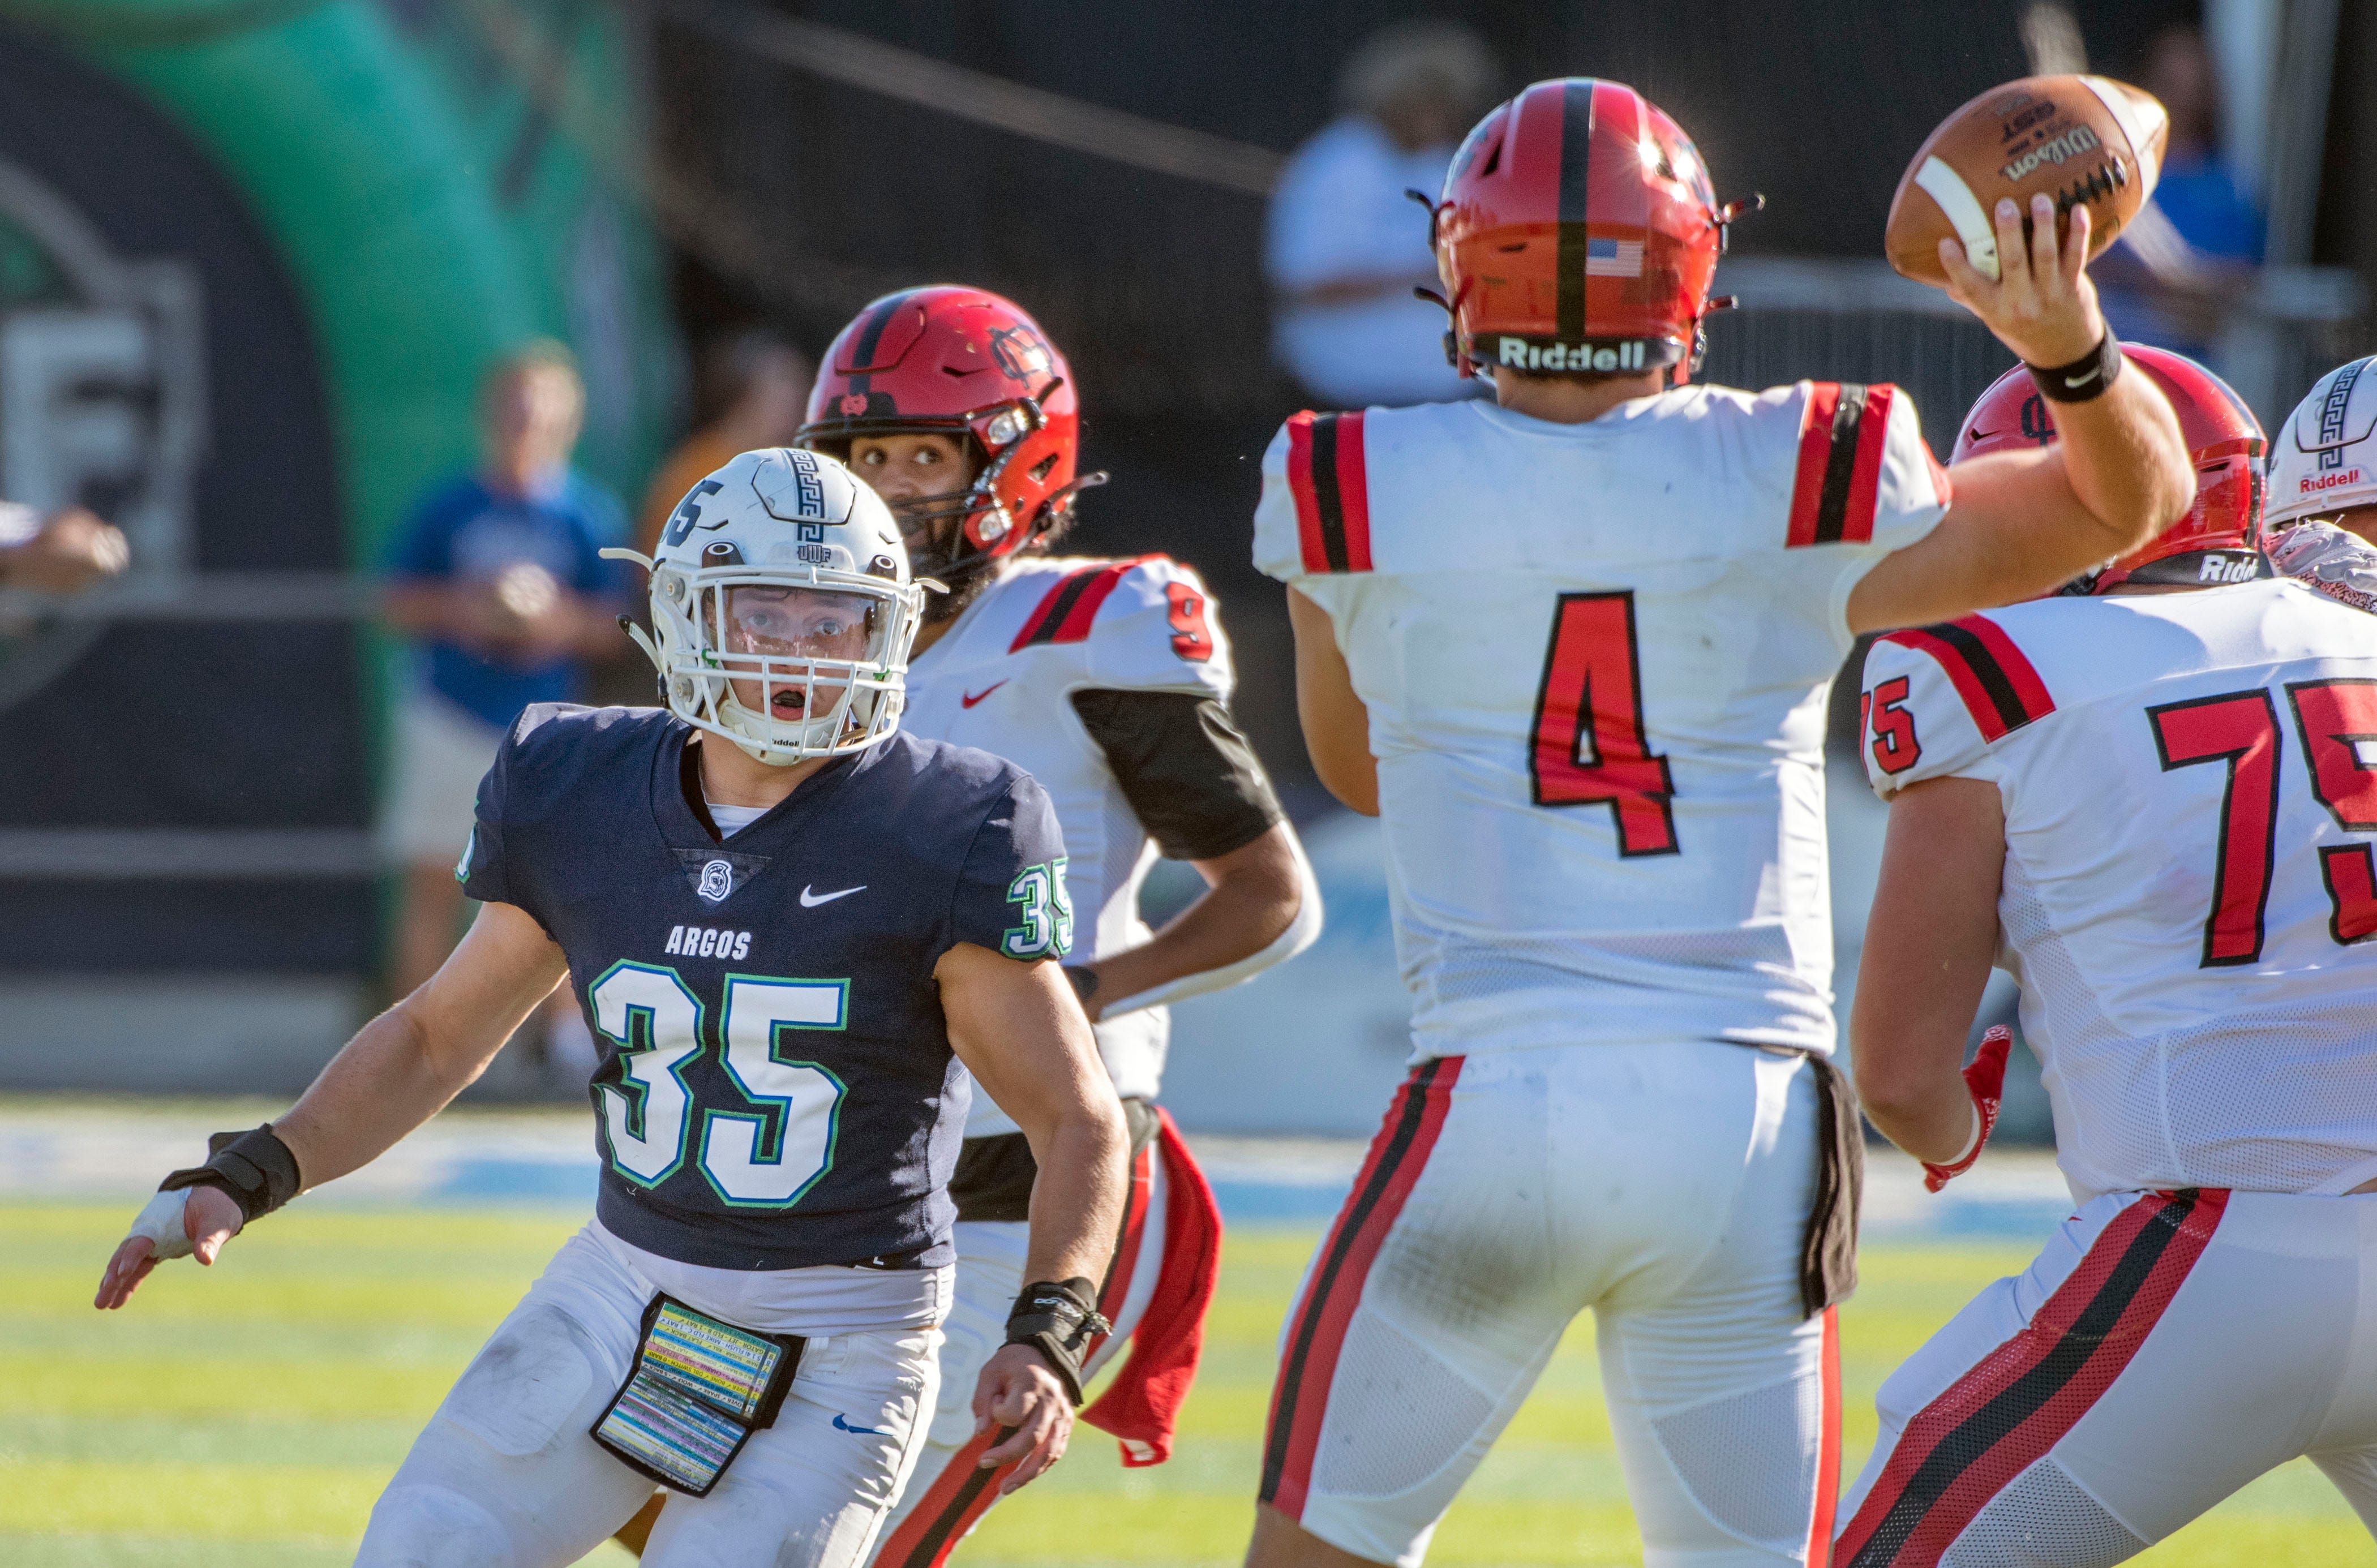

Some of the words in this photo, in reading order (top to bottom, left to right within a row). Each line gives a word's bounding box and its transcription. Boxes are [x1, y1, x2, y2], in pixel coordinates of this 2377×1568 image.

[2003, 123, 2100, 182] Wilson
[1499, 336, 1645, 371] Riddell
[2299, 470, 2359, 493] Riddell
[666, 480, 724, 548] 5
[797, 544, 831, 564] UWF
[1164, 581, 1213, 663] 9
[1526, 588, 1681, 860] 4
[772, 738, 800, 746] iddell
[2144, 678, 2377, 969] 75
[664, 925, 751, 960] ARGOS
[589, 958, 850, 1209] 35
[666, 1320, 679, 1328] RAT
[686, 1320, 698, 1328] RAT
[670, 1329, 688, 1339] BACK
[688, 1335, 702, 1345] FLAT
[692, 1330, 704, 1338] FLD
[705, 1335, 720, 1345] MIKE
[724, 1343, 744, 1355] FLUSH
[742, 1342, 763, 1354] GATOR
[649, 1365, 663, 1374] BACK
[671, 1360, 692, 1372] SWITCH
[677, 1377, 693, 1387] WOLF
[731, 1384, 746, 1394] OVER
[727, 1397, 742, 1407] OVER
